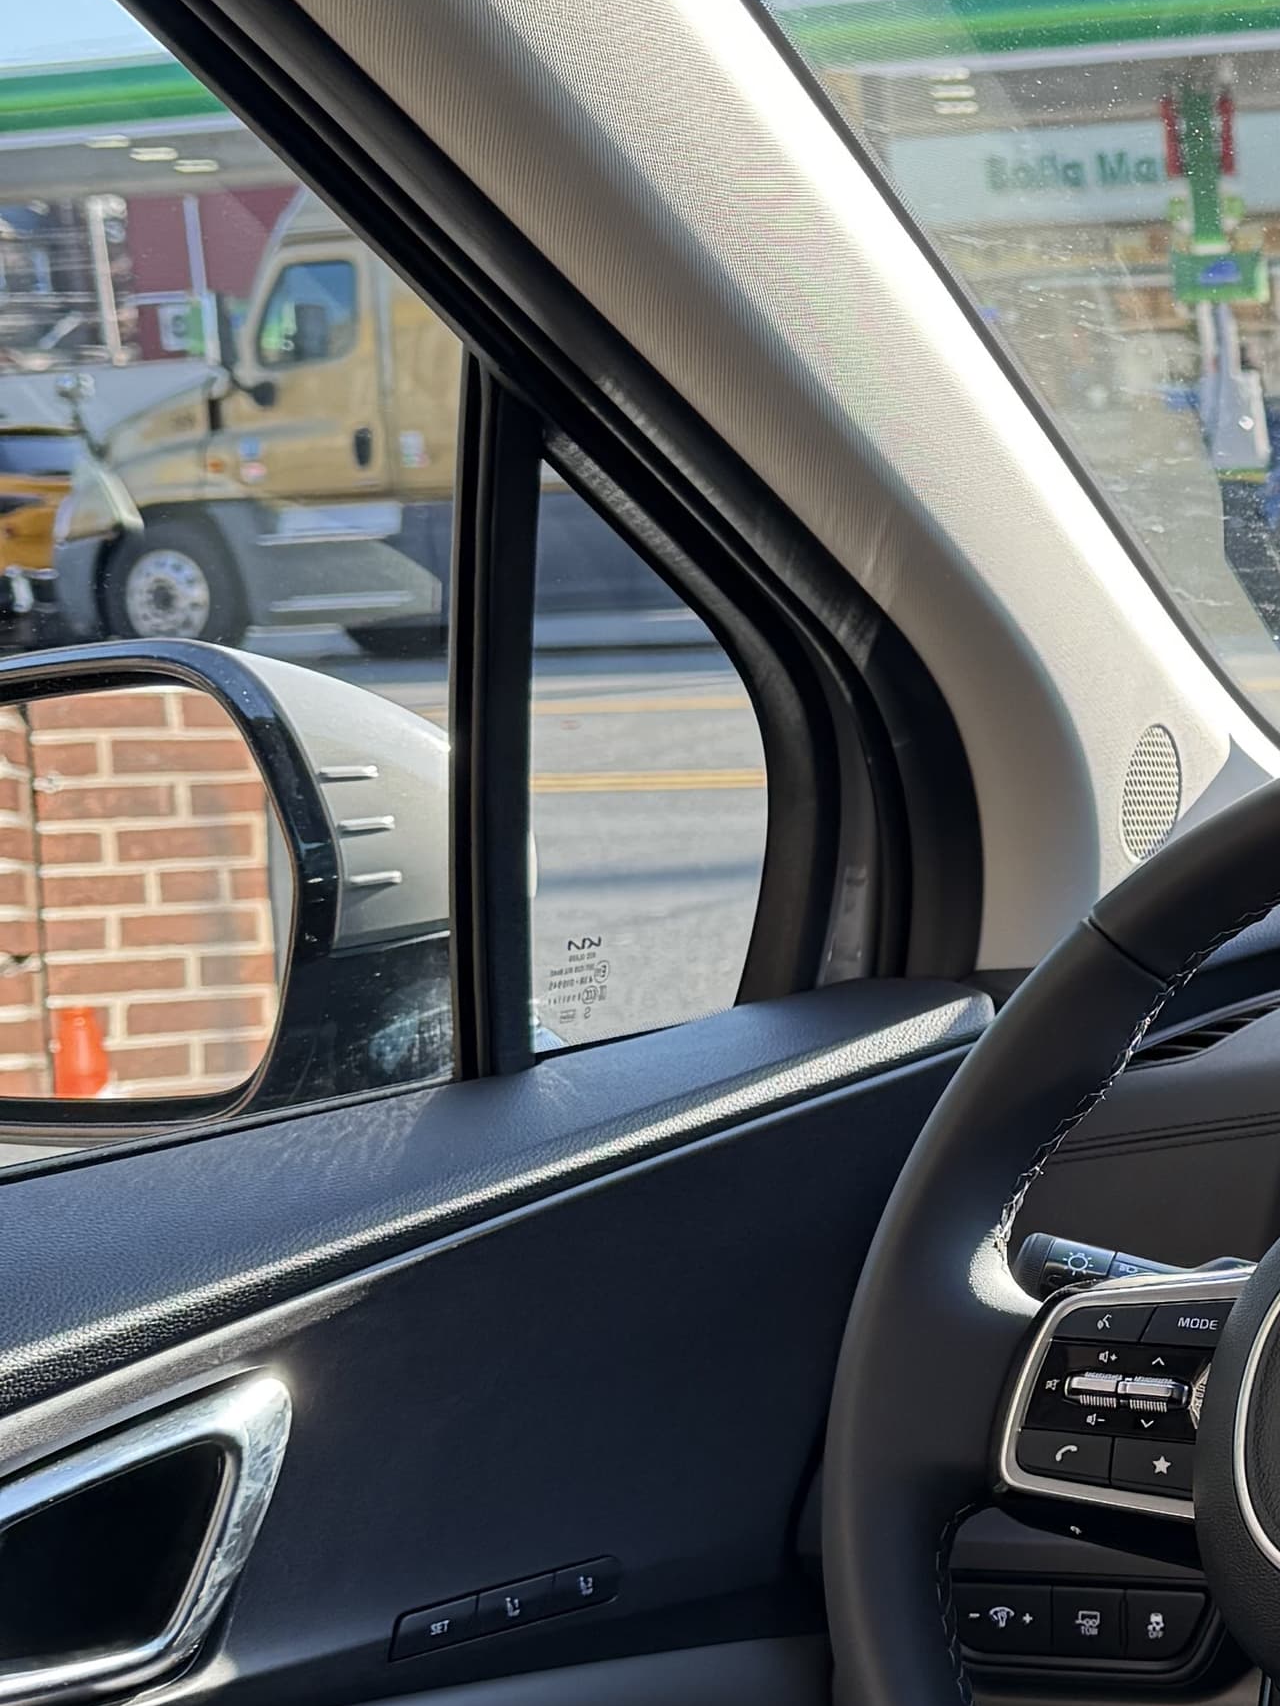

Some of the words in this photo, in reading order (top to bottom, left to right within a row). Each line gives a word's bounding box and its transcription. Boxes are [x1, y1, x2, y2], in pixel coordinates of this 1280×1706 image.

[1177, 1315, 1219, 1332] MODE
[430, 1618, 451, 1636] SET
[1080, 1625, 1099, 1637] TOW
[1147, 1629, 1165, 1640] OFF
